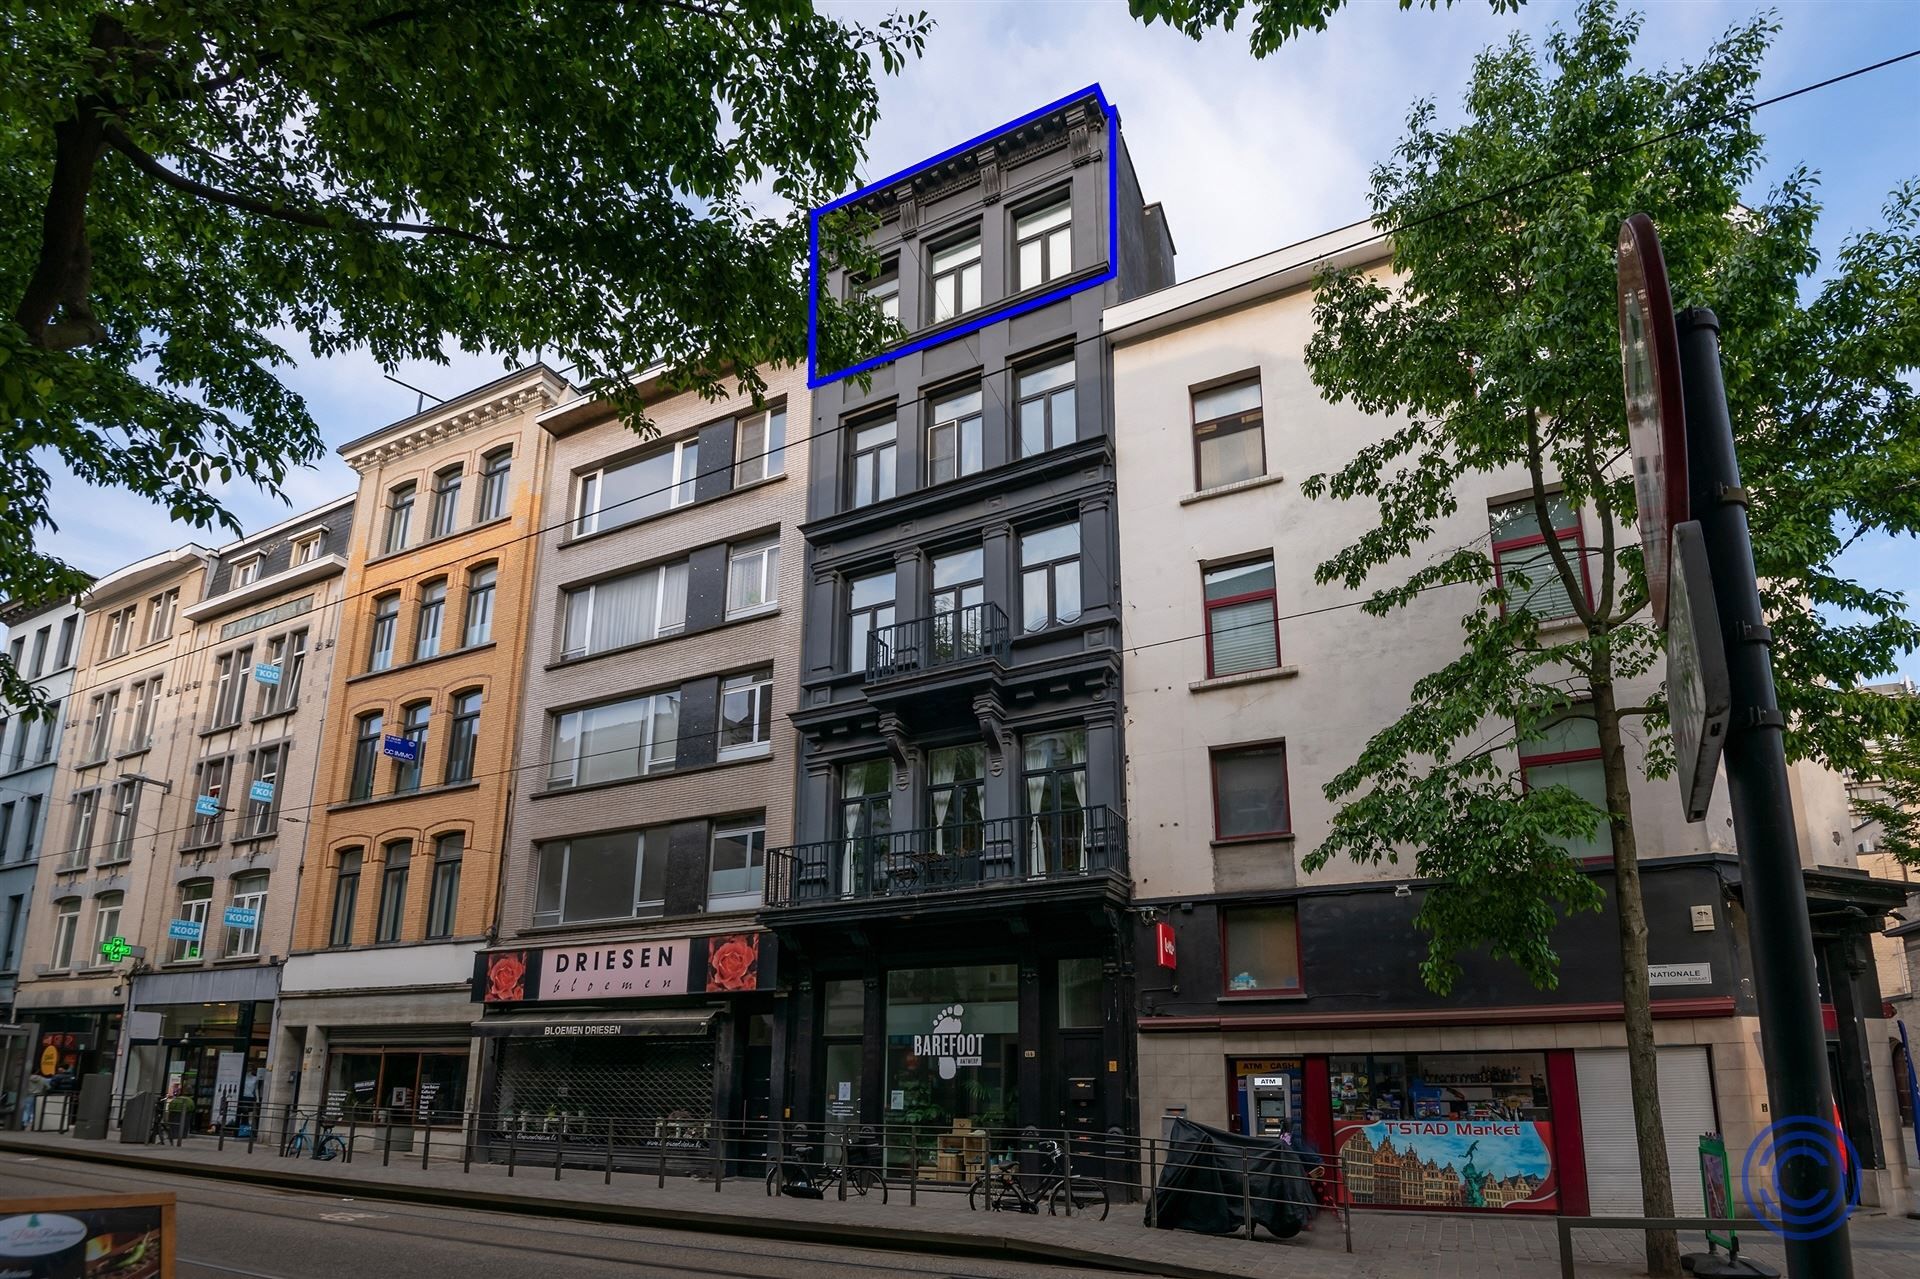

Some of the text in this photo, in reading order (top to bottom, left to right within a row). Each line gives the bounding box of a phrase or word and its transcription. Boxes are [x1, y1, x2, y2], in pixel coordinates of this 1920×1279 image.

[556, 946, 673, 973] DRIESEN
[1650, 970, 1701, 978] NATIONALE
[553, 978, 671, 993] bloemen
[544, 1025, 621, 1036] BLOEMEN DRIESEN
[914, 1033, 985, 1056] BAREFOOT
[1243, 1062, 1263, 1070] ATM
[1270, 1062, 1295, 1070] CASH
[1385, 1122, 1521, 1136] T'STAD Market
